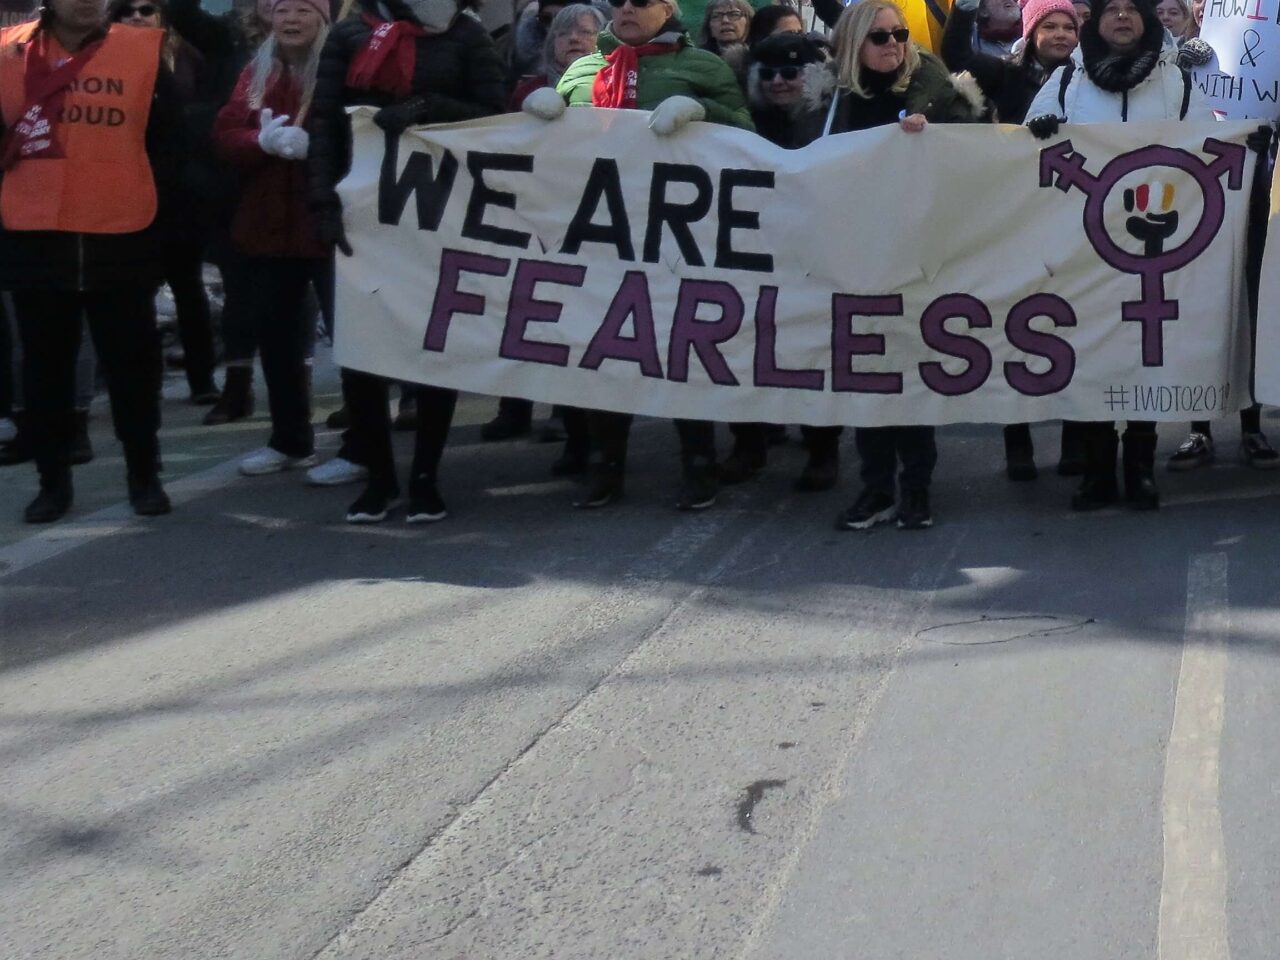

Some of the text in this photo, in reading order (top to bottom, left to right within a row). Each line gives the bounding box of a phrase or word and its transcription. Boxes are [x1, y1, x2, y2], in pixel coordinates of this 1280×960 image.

[1193, 71, 1244, 102] WITH
[1240, 28, 1266, 67] &
[378, 137, 776, 273] WE ARE
[422, 247, 1078, 398] FEARLESS
